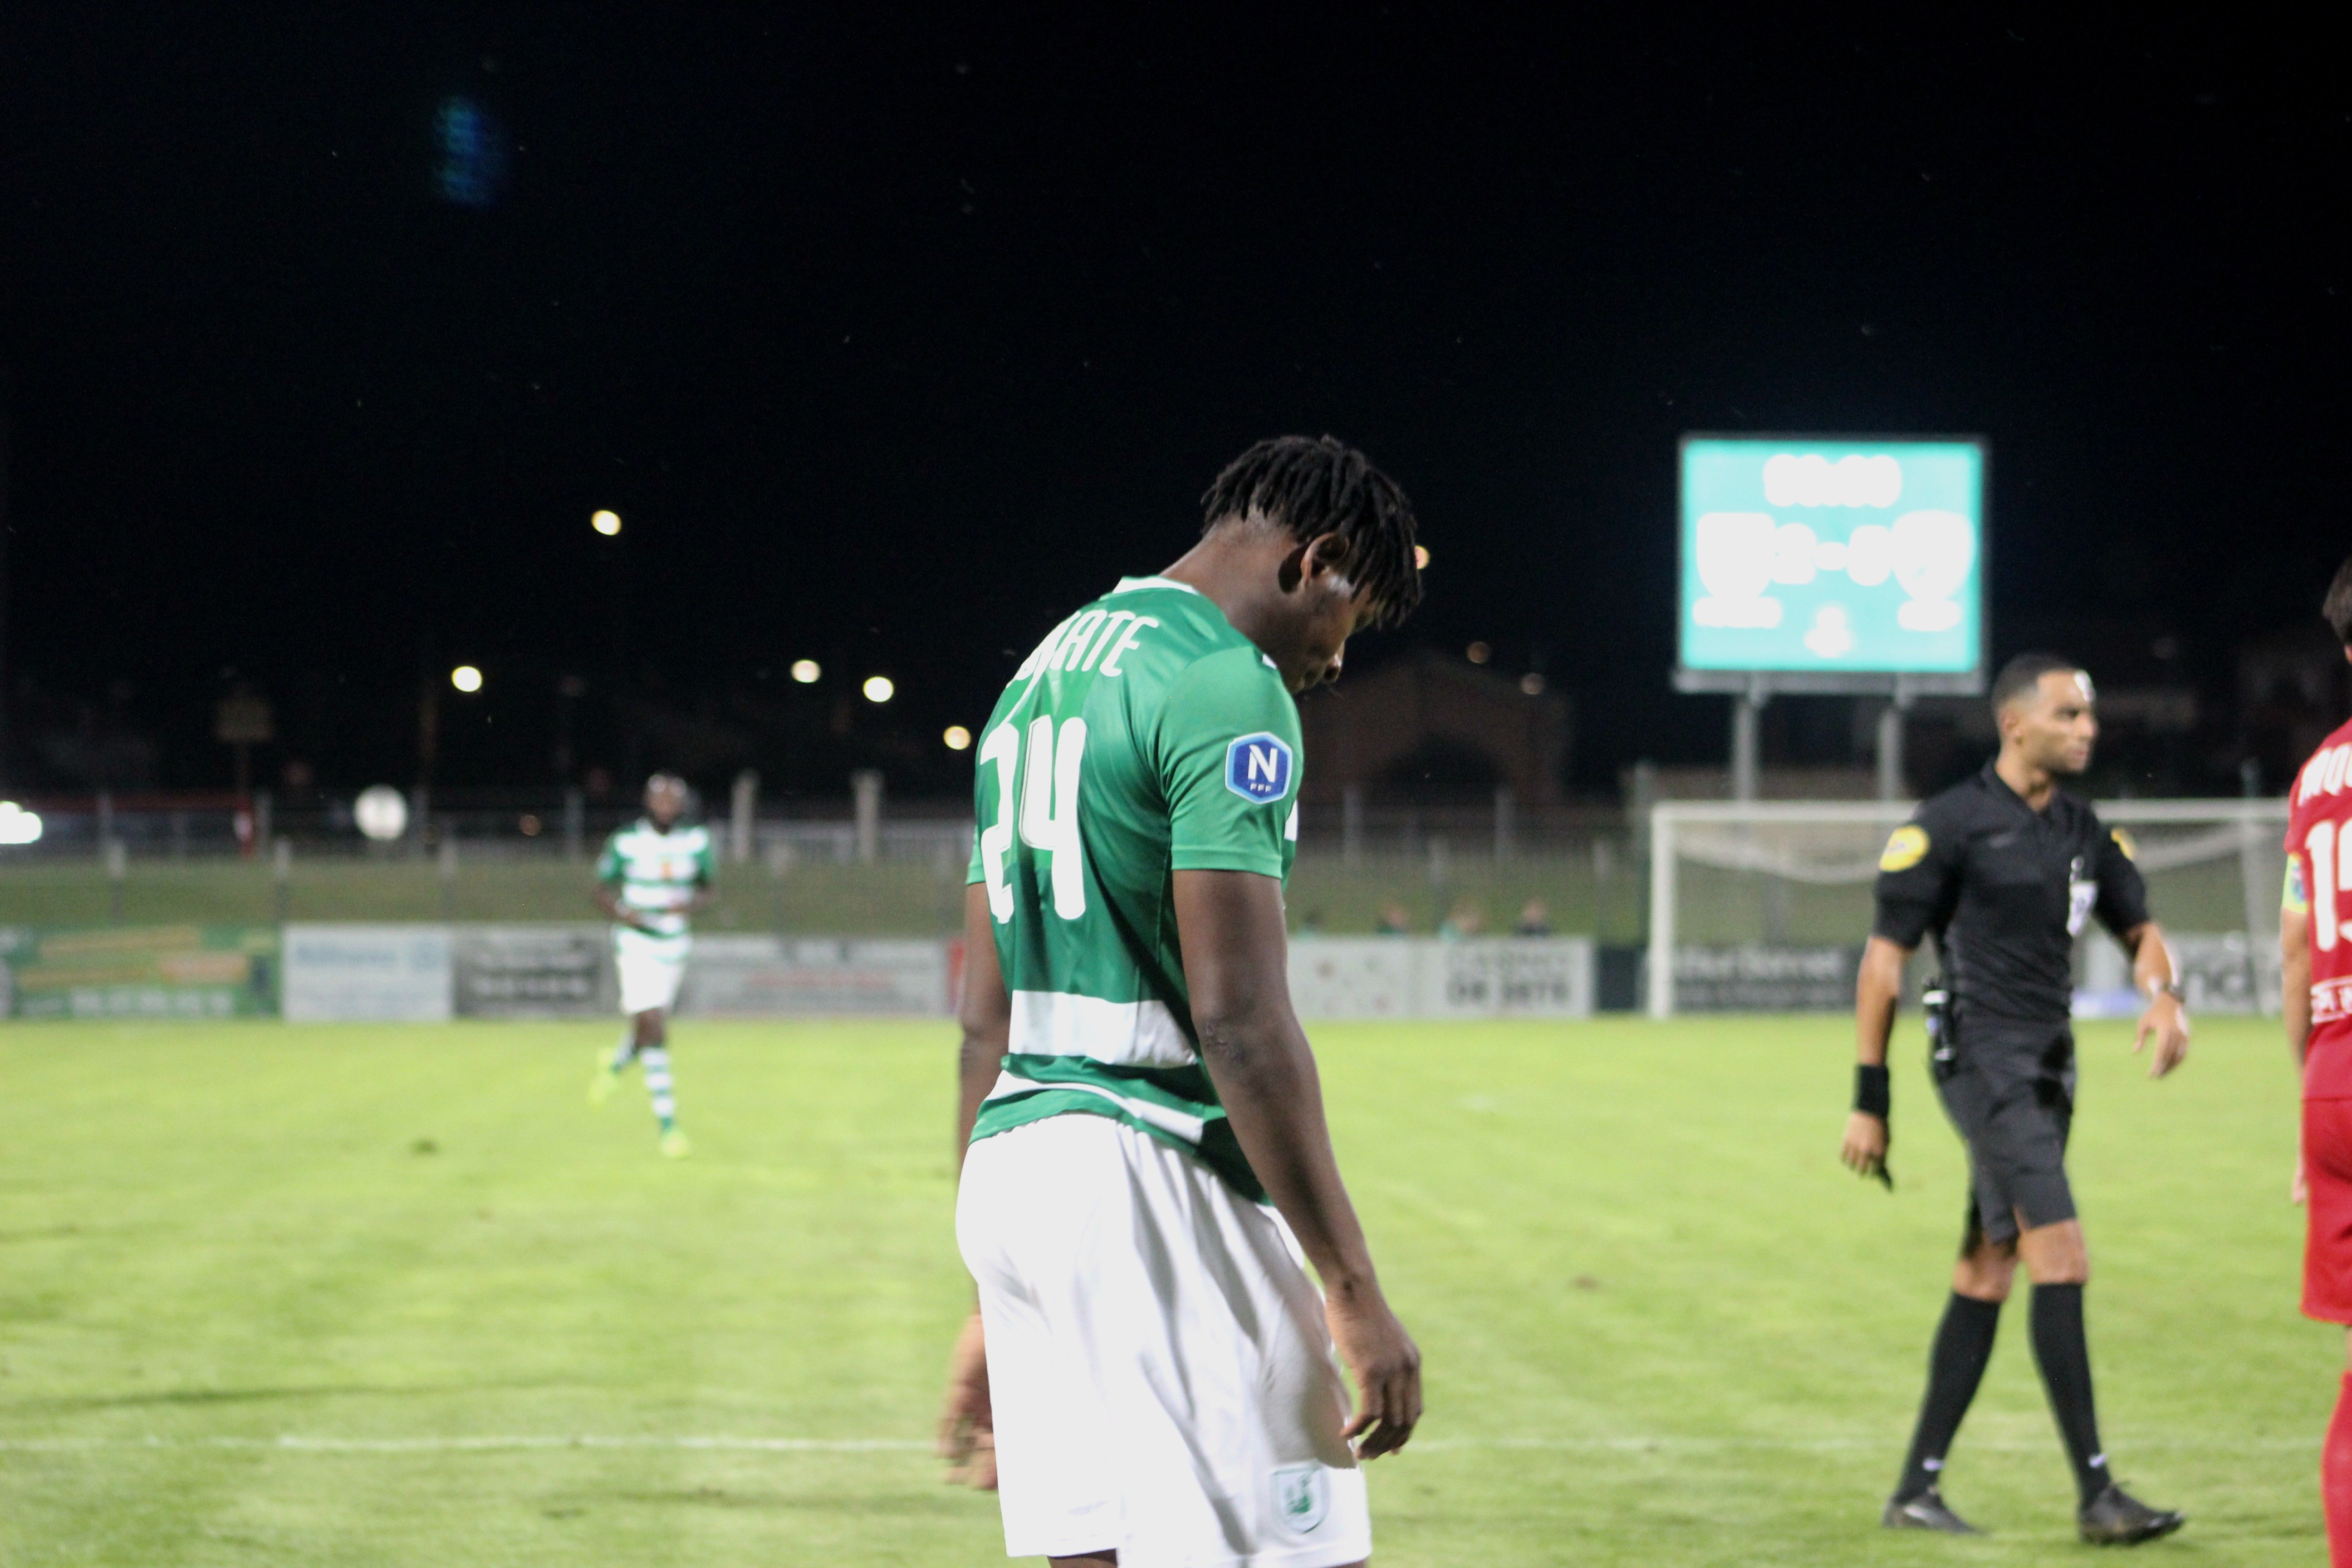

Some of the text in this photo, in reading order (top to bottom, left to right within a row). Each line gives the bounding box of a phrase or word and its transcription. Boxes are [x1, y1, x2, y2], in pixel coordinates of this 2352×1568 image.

[1248, 744, 1278, 783] N
[1250, 783, 1271, 793] FFF
[980, 715, 1087, 924] 24
